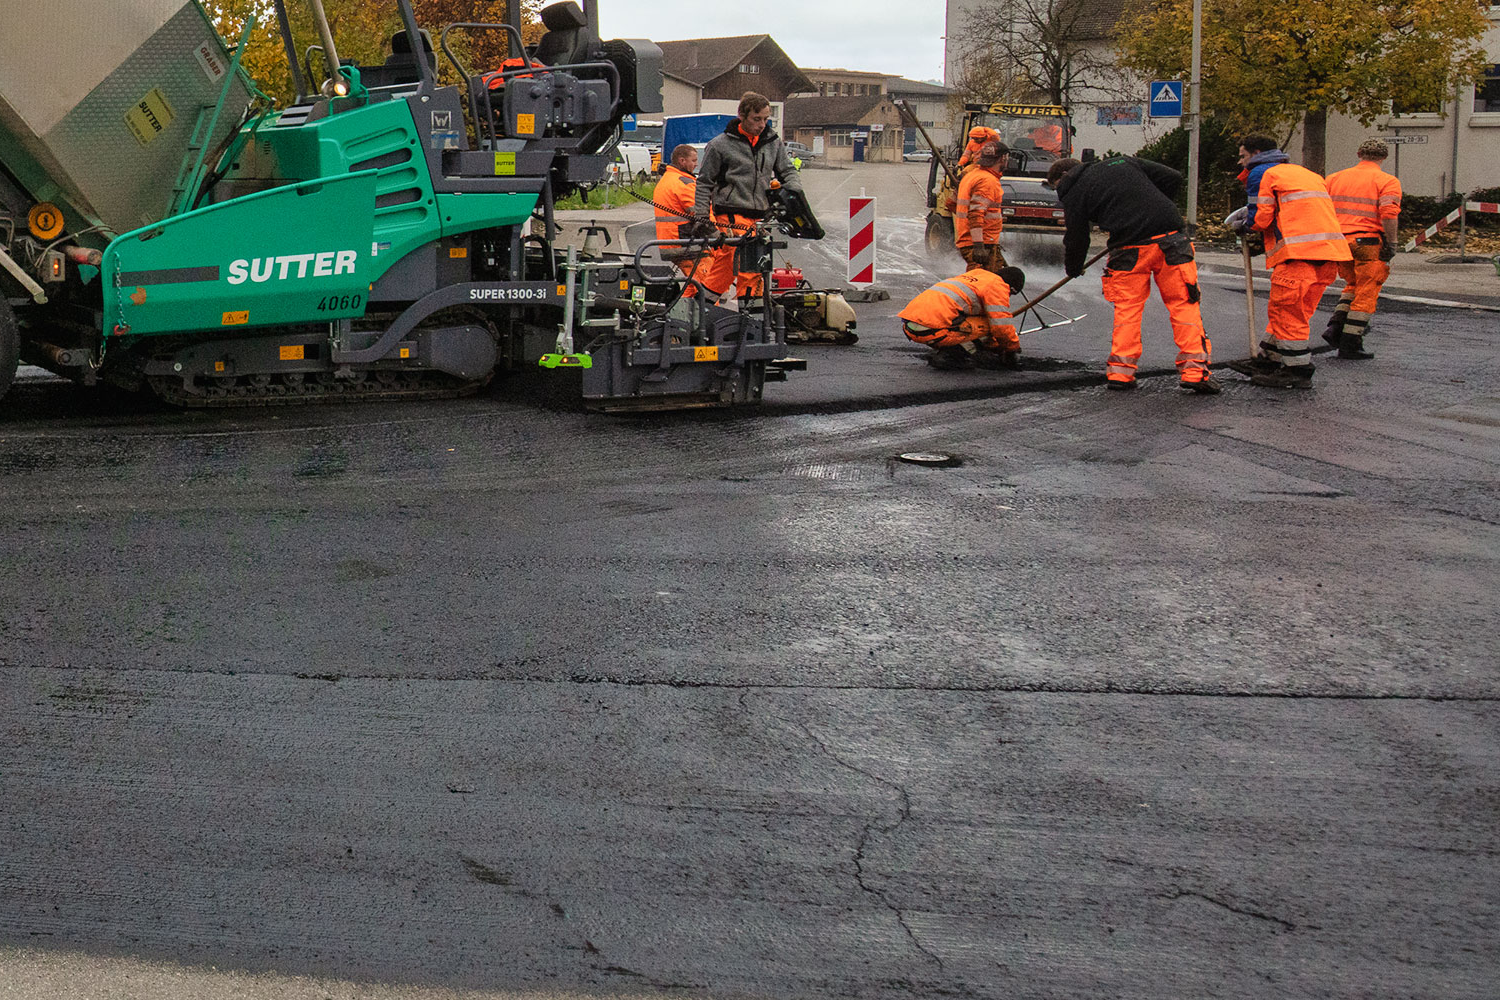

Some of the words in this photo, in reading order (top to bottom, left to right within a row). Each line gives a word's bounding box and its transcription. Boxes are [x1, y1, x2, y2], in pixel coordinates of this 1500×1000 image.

[201, 47, 221, 75] GRABER
[139, 101, 162, 132] SUTTER
[1002, 105, 1052, 115] SUTTER
[227, 250, 357, 285] SUTTER
[317, 294, 361, 312] 4060
[469, 289, 505, 299] SUPER
[506, 288, 547, 299] 1300-3i
